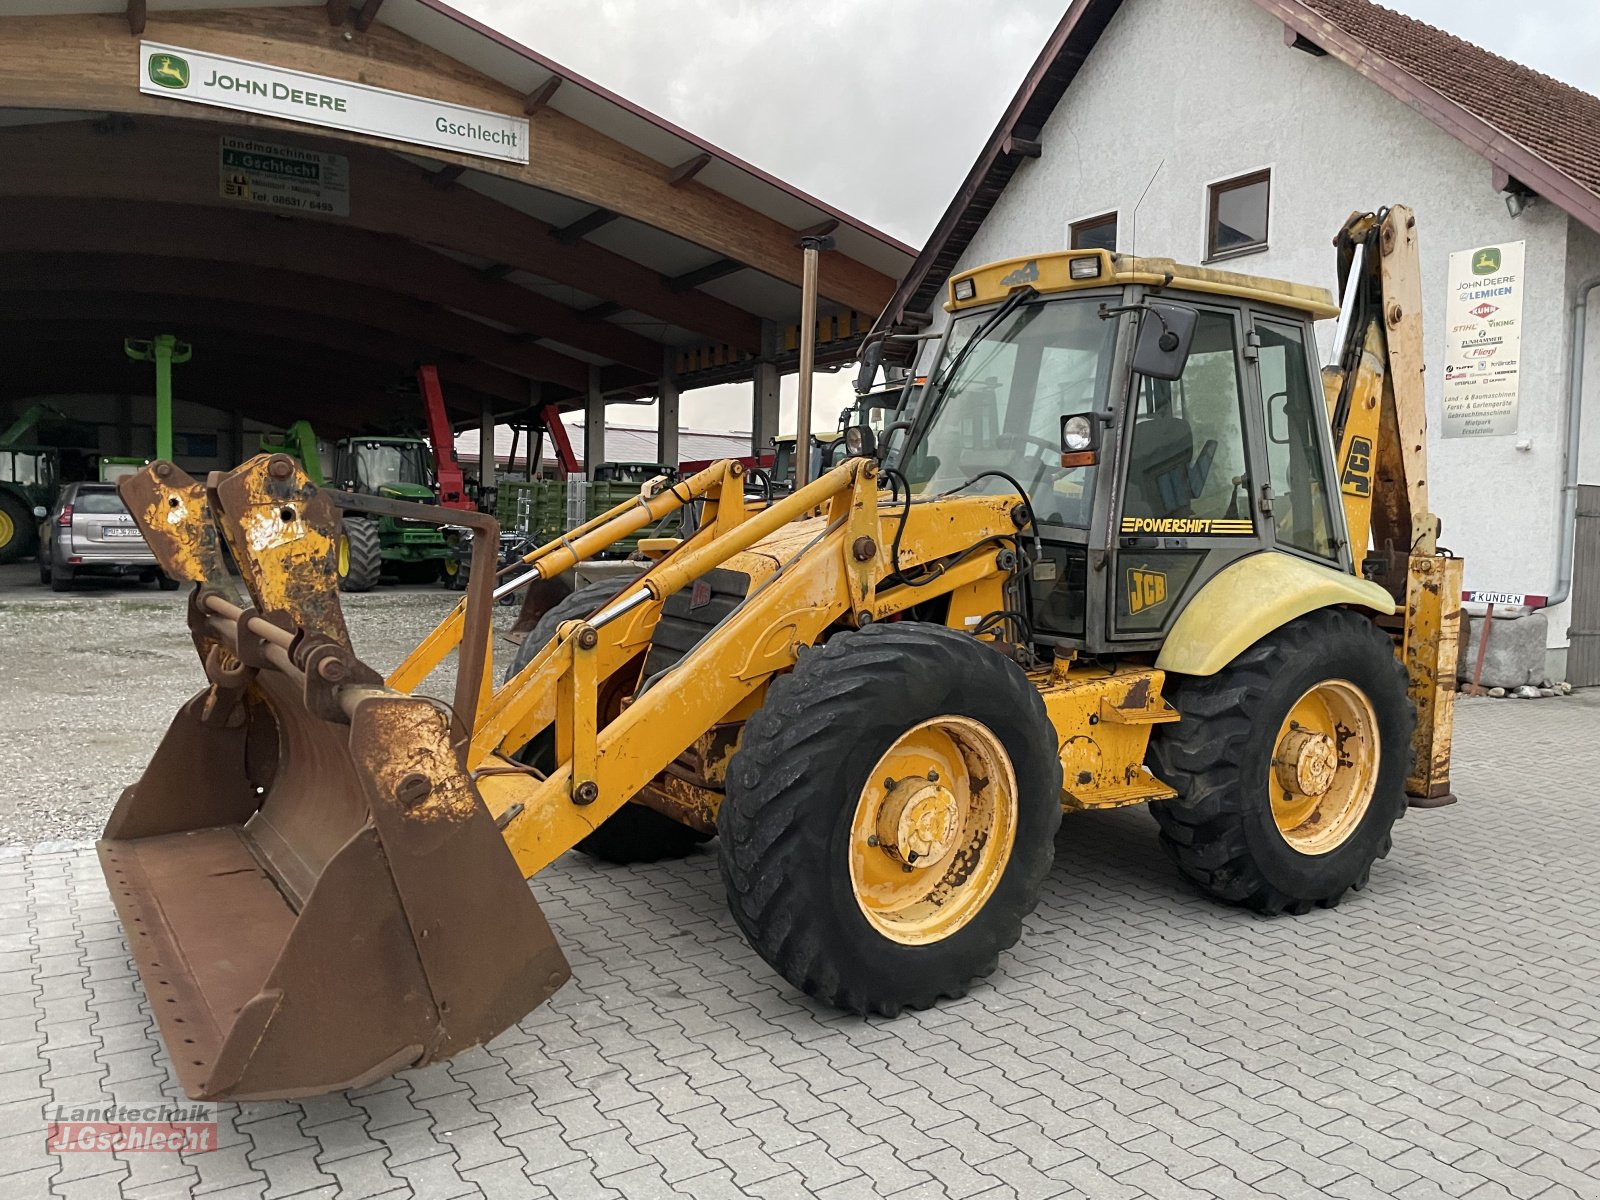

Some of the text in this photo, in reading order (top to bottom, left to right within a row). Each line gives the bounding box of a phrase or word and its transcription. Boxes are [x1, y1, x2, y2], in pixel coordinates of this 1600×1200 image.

[203, 70, 347, 113] JOHN DEERE
[435, 117, 518, 147] Gschlecht
[221, 136, 321, 163] Landmaschinen
[242, 156, 316, 178] Gschlecht
[252, 191, 270, 202] Tel.
[1469, 286, 1512, 300] LEMKEN
[1471, 305, 1497, 315] KUHN
[1452, 324, 1478, 333] STIHL
[1487, 319, 1515, 328] VIKING
[1472, 347, 1498, 357] Fliegl
[1470, 391, 1516, 400] Baumaschinen
[1447, 409, 1511, 419] Gebrauchtmaschinen
[1344, 440, 1370, 493] JCB
[1134, 518, 1212, 534] POWERSHIFT
[1131, 571, 1166, 612] JCB
[1478, 593, 1521, 604] KUNDEN
